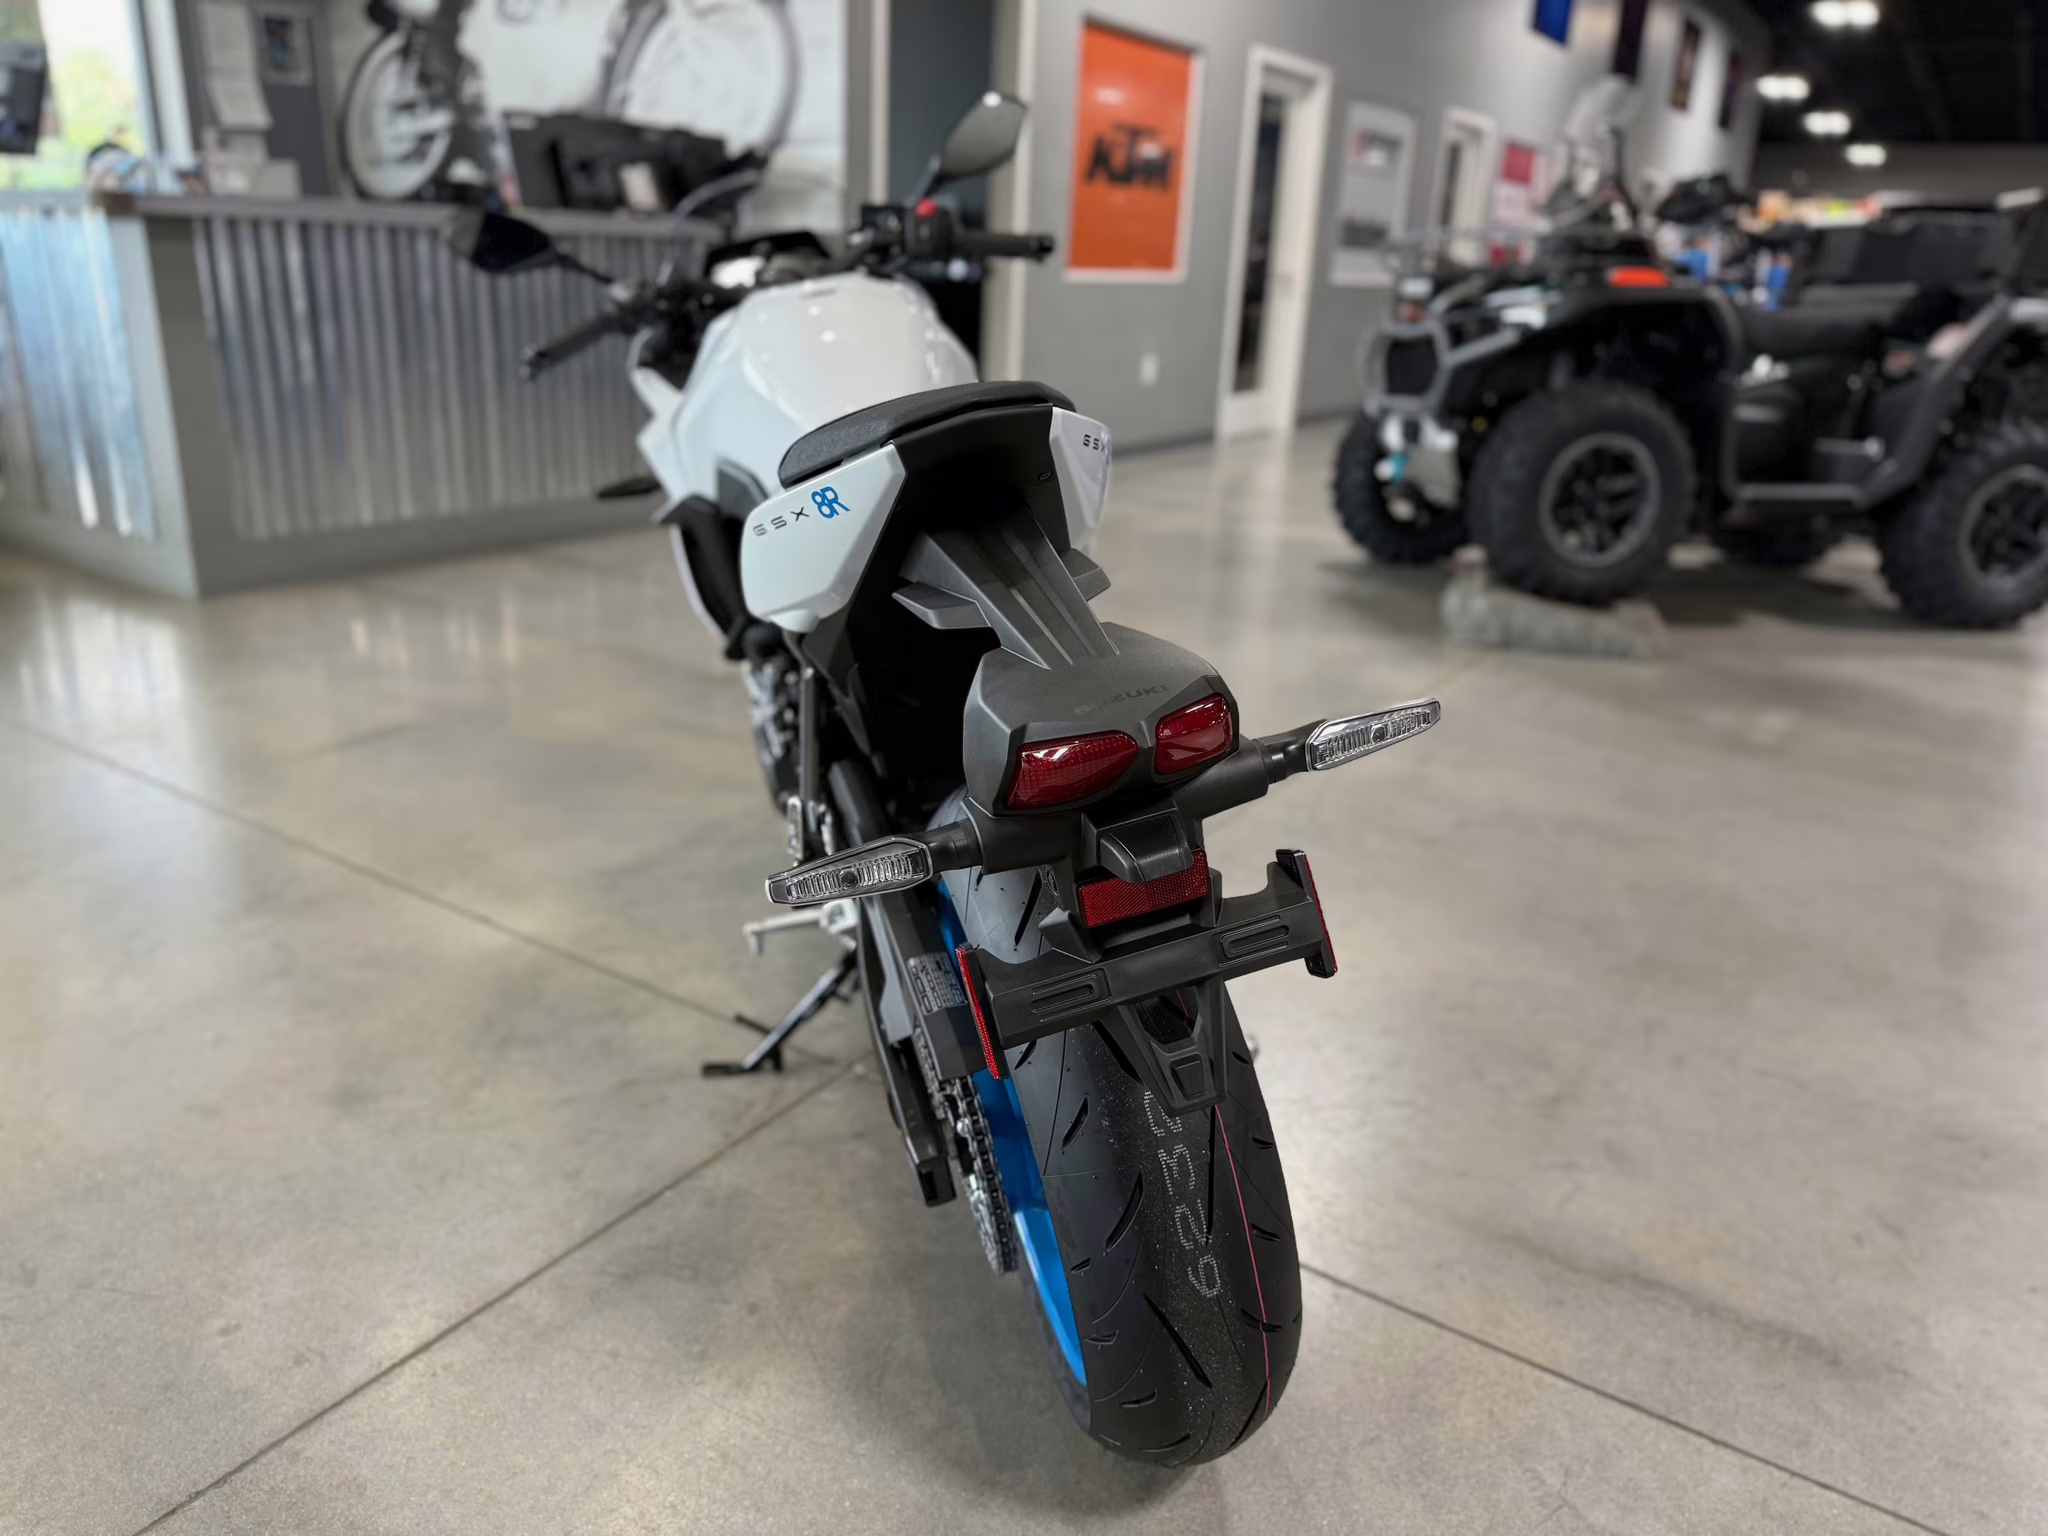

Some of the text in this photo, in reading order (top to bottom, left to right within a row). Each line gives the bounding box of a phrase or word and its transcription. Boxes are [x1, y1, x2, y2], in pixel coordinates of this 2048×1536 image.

[1086, 121, 1175, 191] KTM
[752, 486, 851, 537] GSX 8R
[1143, 1090, 1222, 1298] 6232
